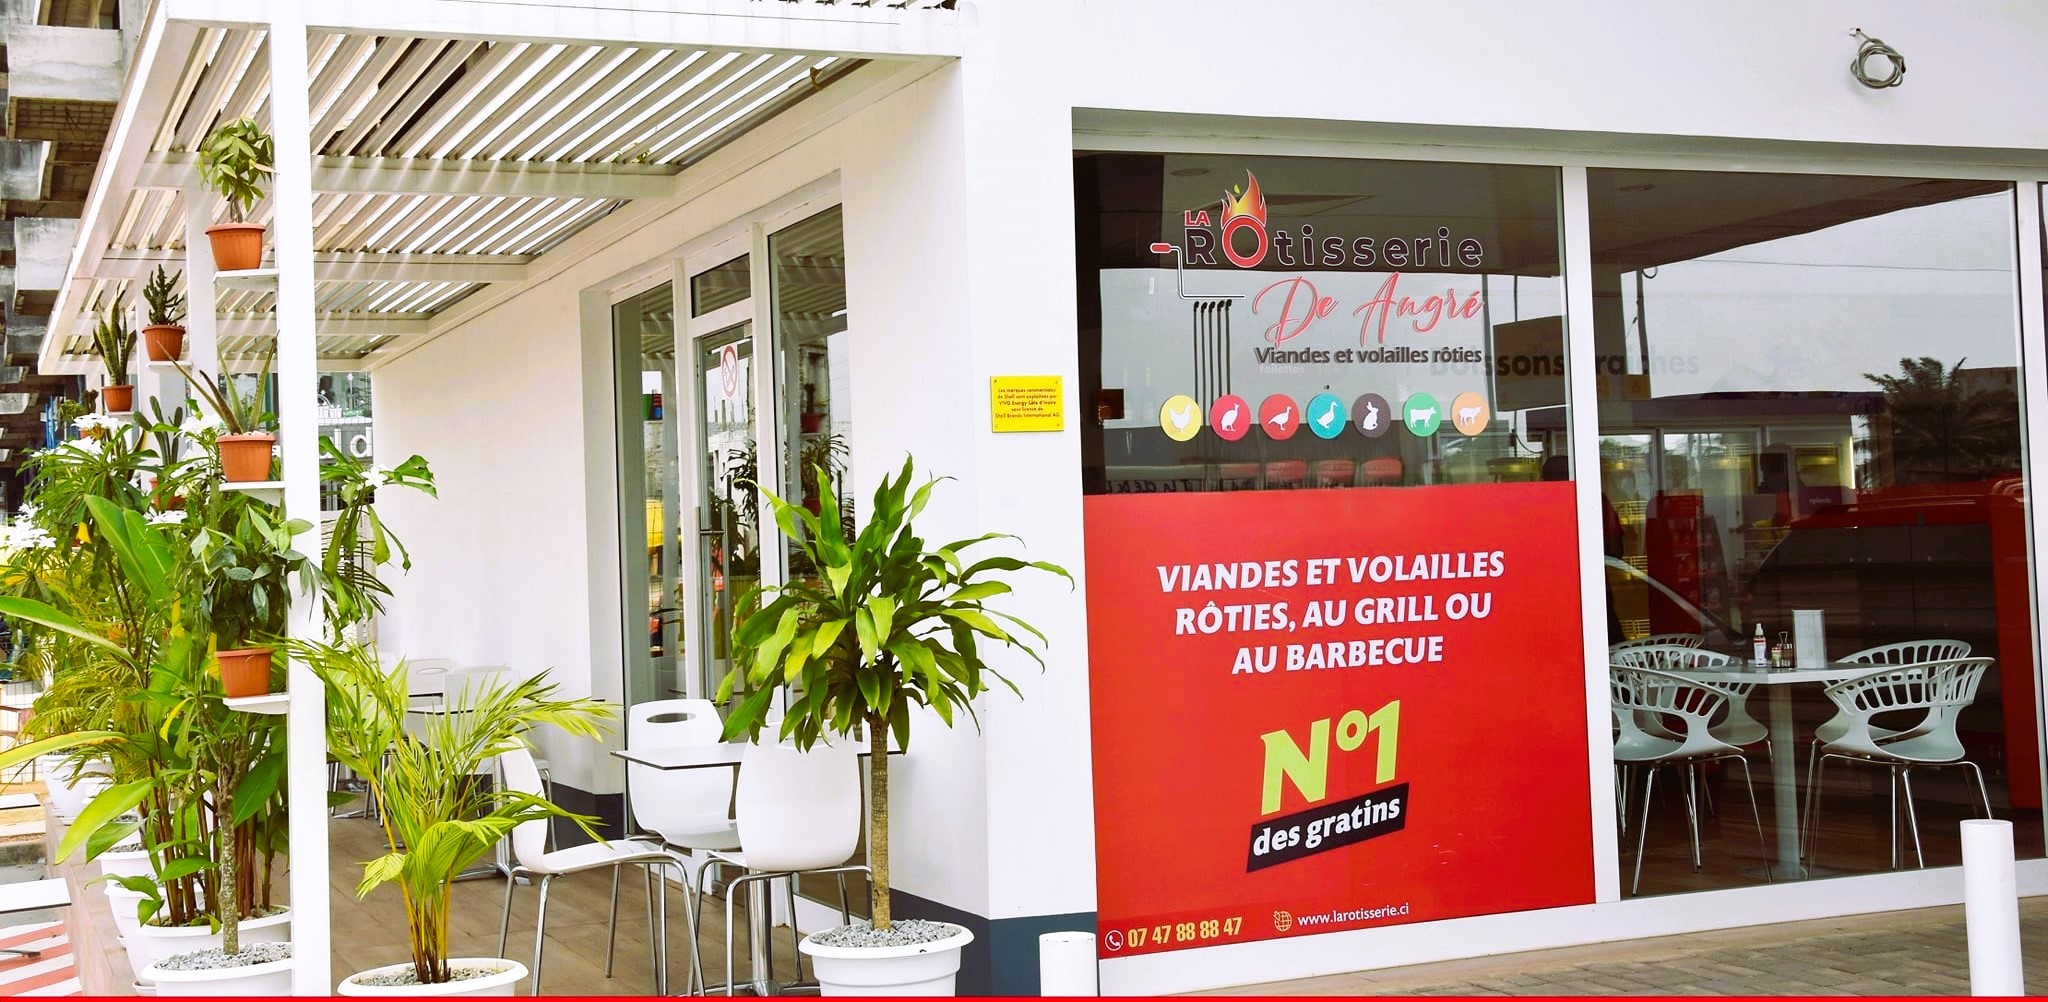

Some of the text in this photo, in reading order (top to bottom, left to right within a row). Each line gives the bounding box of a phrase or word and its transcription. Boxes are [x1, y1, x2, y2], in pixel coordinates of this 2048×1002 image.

[1185, 210, 1211, 226] LA
[1252, 271, 1485, 347] De Angré
[1255, 347, 1482, 364] Viandes et volailles rôties
[1156, 550, 1505, 593] VIANDES ET VOLAILLES
[1175, 592, 1492, 635] RÔTIES, AU GRILL OU
[1231, 635, 1444, 675] AU BARBECUE
[1253, 797, 1400, 856] des gratins
[1127, 917, 1243, 948] 07 47 88 88 47
[1297, 903, 1409, 926] www.larotisserie.ci
